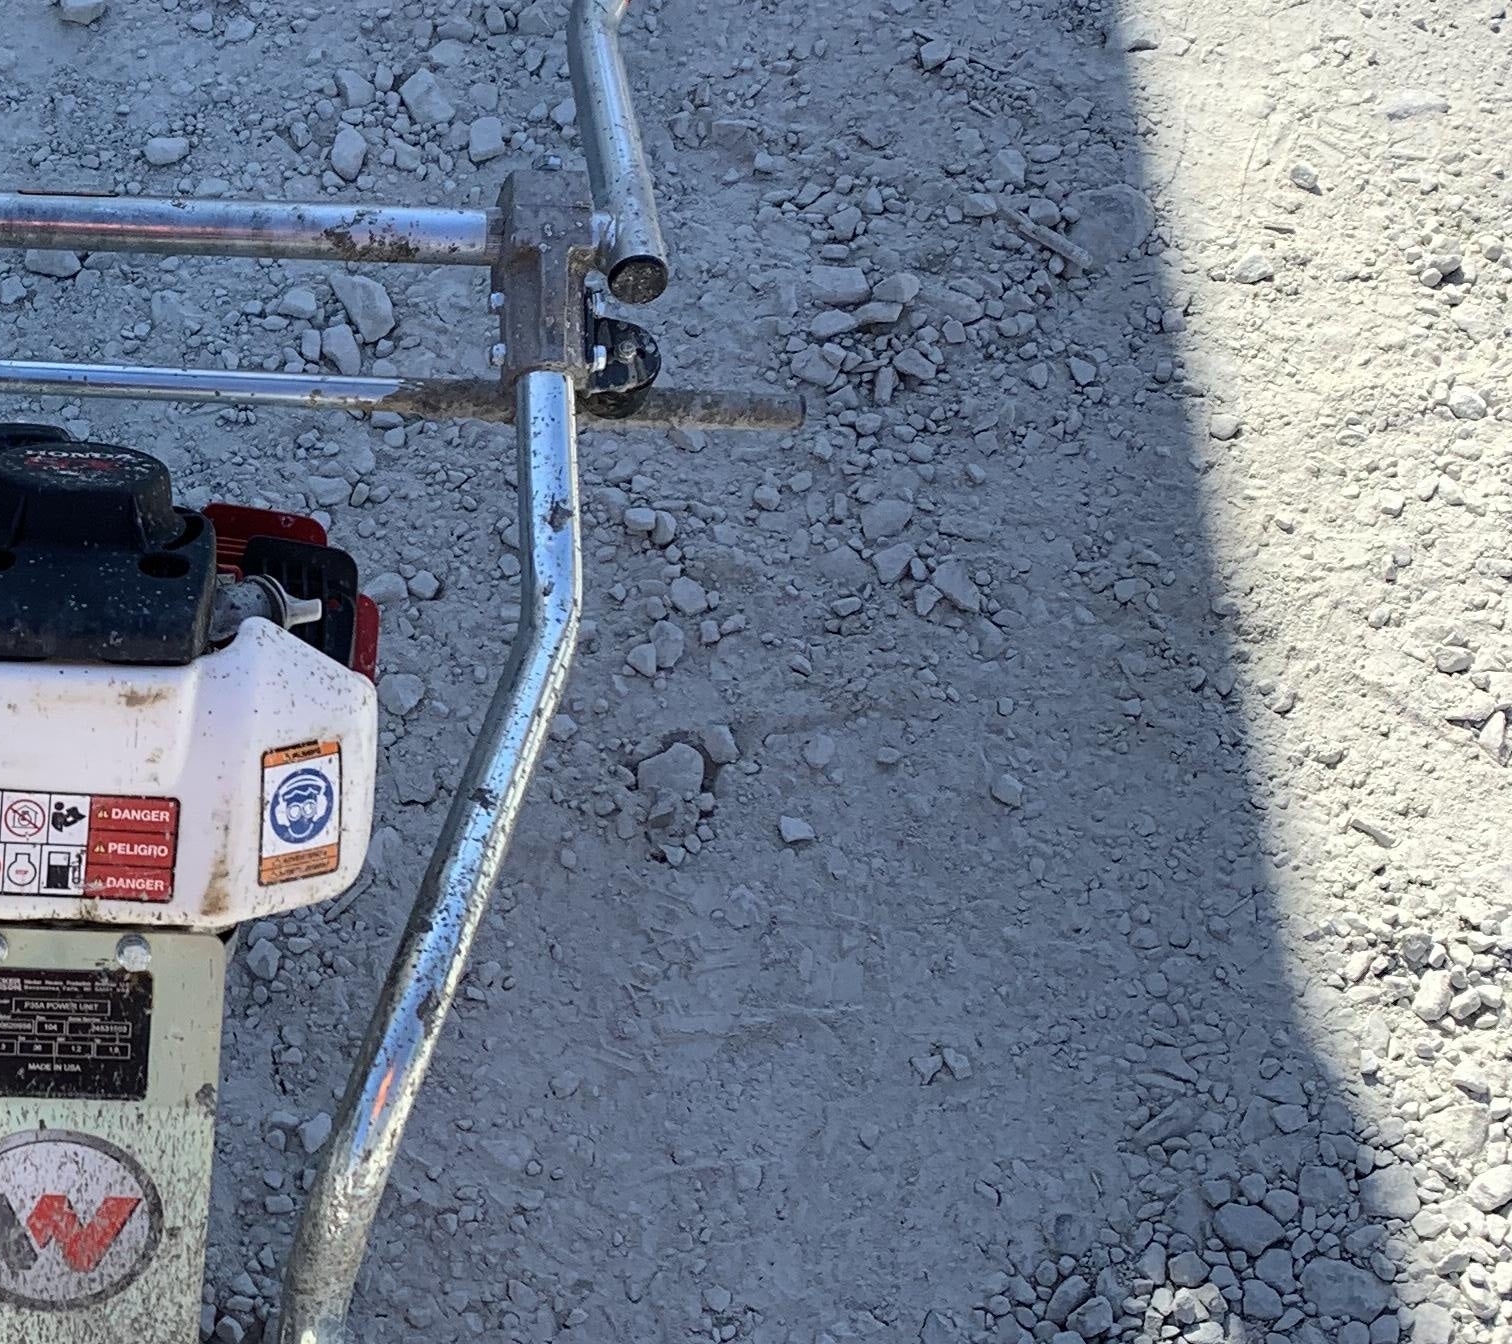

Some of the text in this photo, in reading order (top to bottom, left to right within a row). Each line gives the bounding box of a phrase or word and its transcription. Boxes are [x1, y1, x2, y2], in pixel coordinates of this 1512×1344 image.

[24, 449, 135, 461] HONDA
[111, 808, 170, 823] DANGER
[108, 842, 169, 858] PELIGRO
[106, 877, 165, 892] DANGER
[46, 1002, 78, 1010] POWER
[79, 1003, 98, 1011] UNIT
[28, 1062, 82, 1072] MADE IN USA
